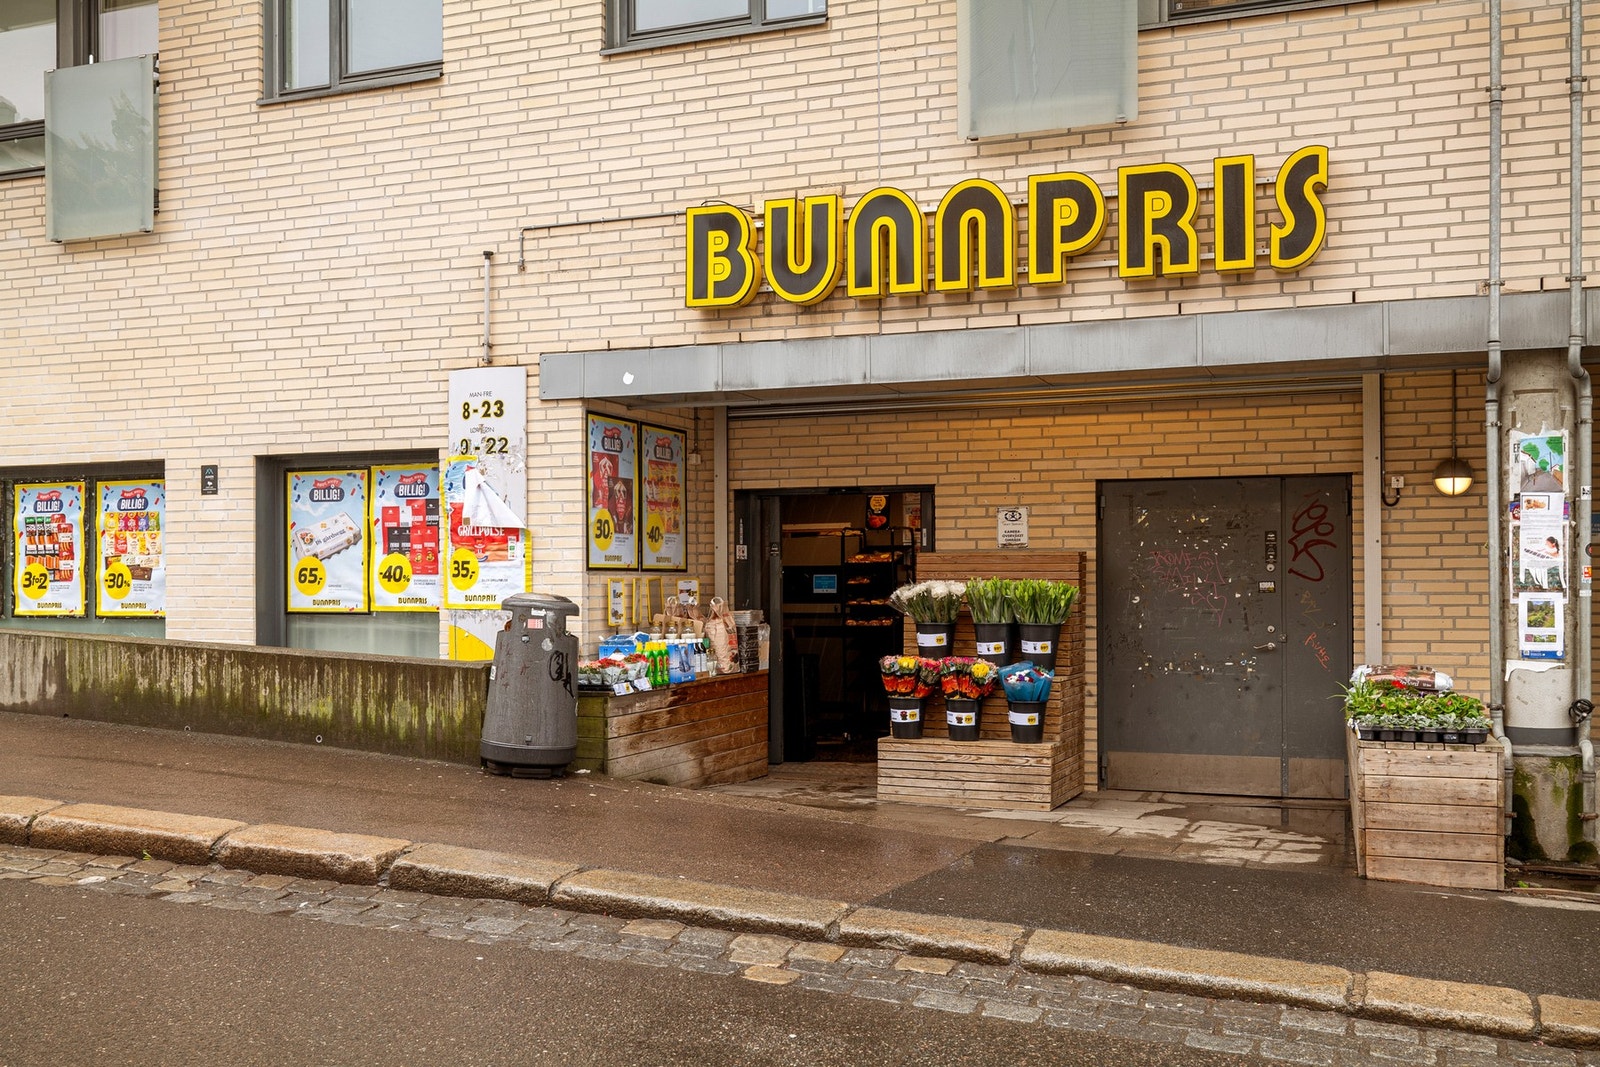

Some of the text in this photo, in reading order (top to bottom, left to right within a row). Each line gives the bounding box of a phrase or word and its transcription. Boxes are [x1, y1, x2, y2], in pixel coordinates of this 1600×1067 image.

[685, 145, 1330, 309] BUNNPRIS
[313, 488, 340, 501] BILLIG!
[399, 484, 426, 496] BILLIG!
[36, 500, 60, 512] BILLIG!
[120, 498, 145, 510] BILLIG!
[298, 567, 323, 586] 65,-
[379, 565, 411, 583] -40%
[452, 560, 476, 580] 35,-
[105, 572, 131, 589] -30%
[464, 594, 497, 602] BUNNPRIS
